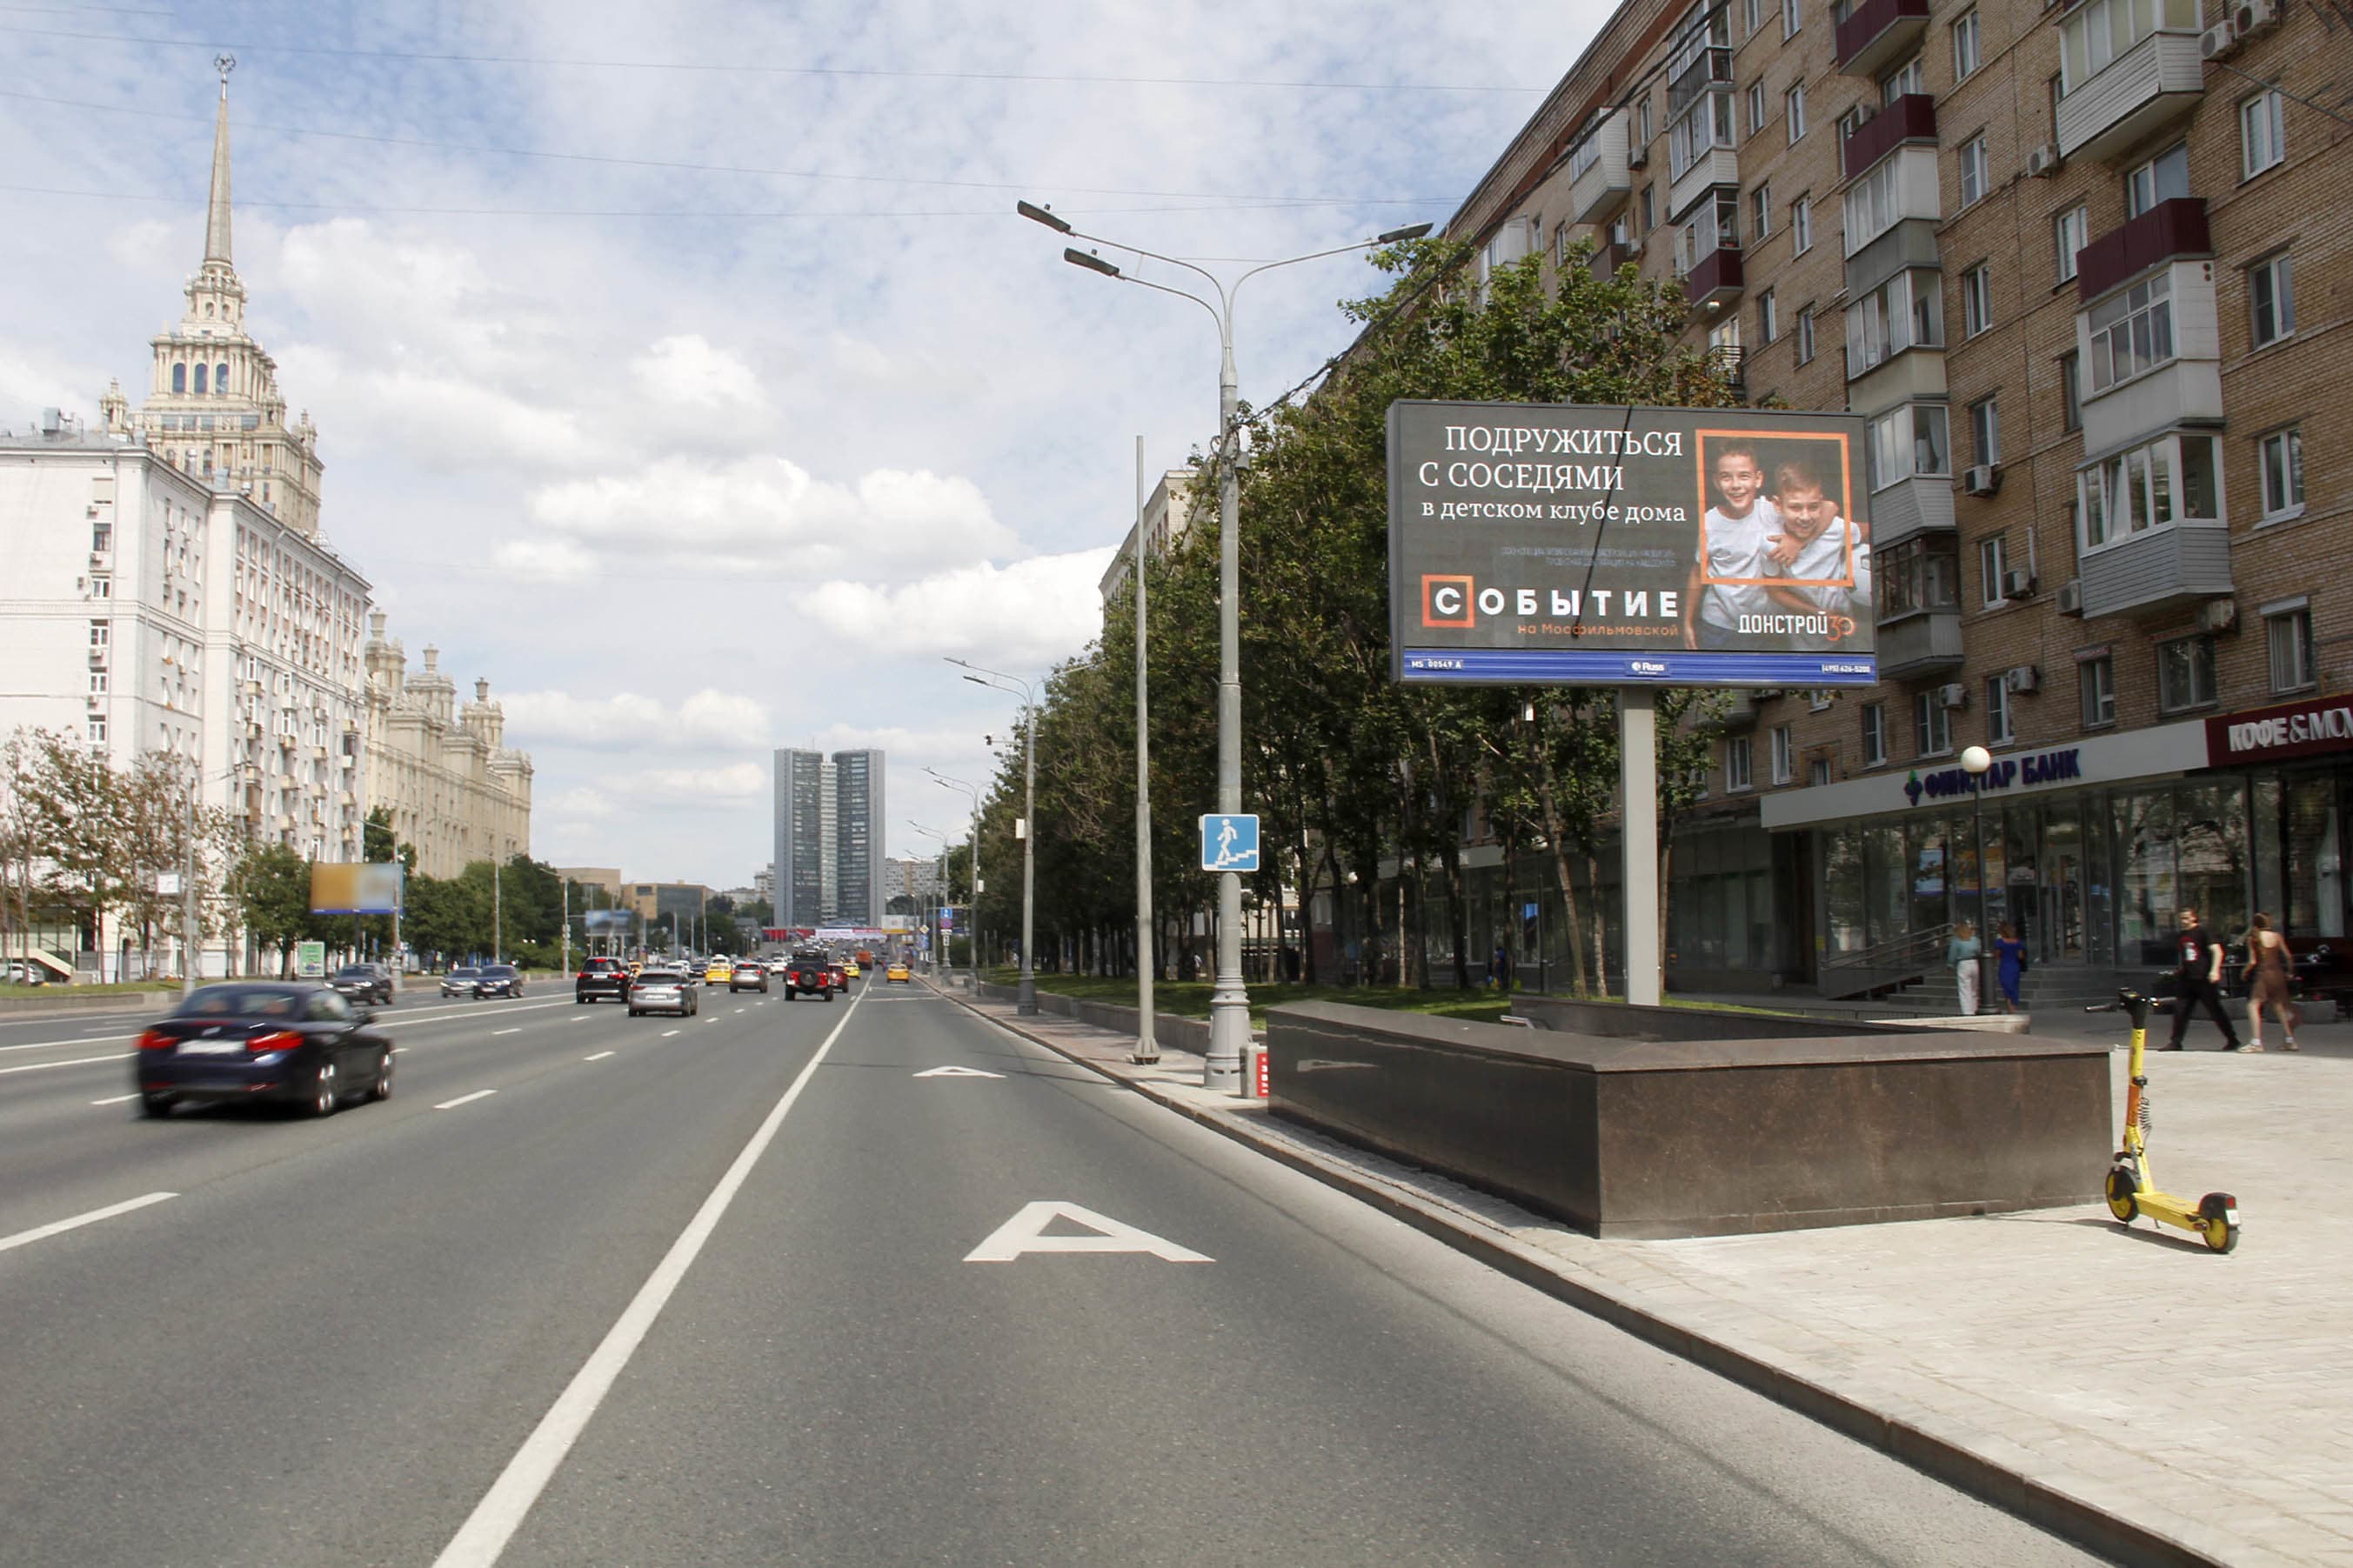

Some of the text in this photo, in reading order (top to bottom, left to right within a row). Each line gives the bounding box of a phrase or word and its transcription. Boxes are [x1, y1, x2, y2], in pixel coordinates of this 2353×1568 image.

[1445, 426, 1683, 457] ПОДРУЖИТЬСЯ
[1419, 462, 1624, 494] С СОСЕДЯМИ
[1421, 500, 1687, 525] в детском клубе дома
[1435, 586, 1678, 617] СОБЫТИЕ
[1517, 624, 1537, 635] на
[1738, 611, 1828, 634] ДОНСТРОЙ
[2022, 749, 2081, 784] БАНК
